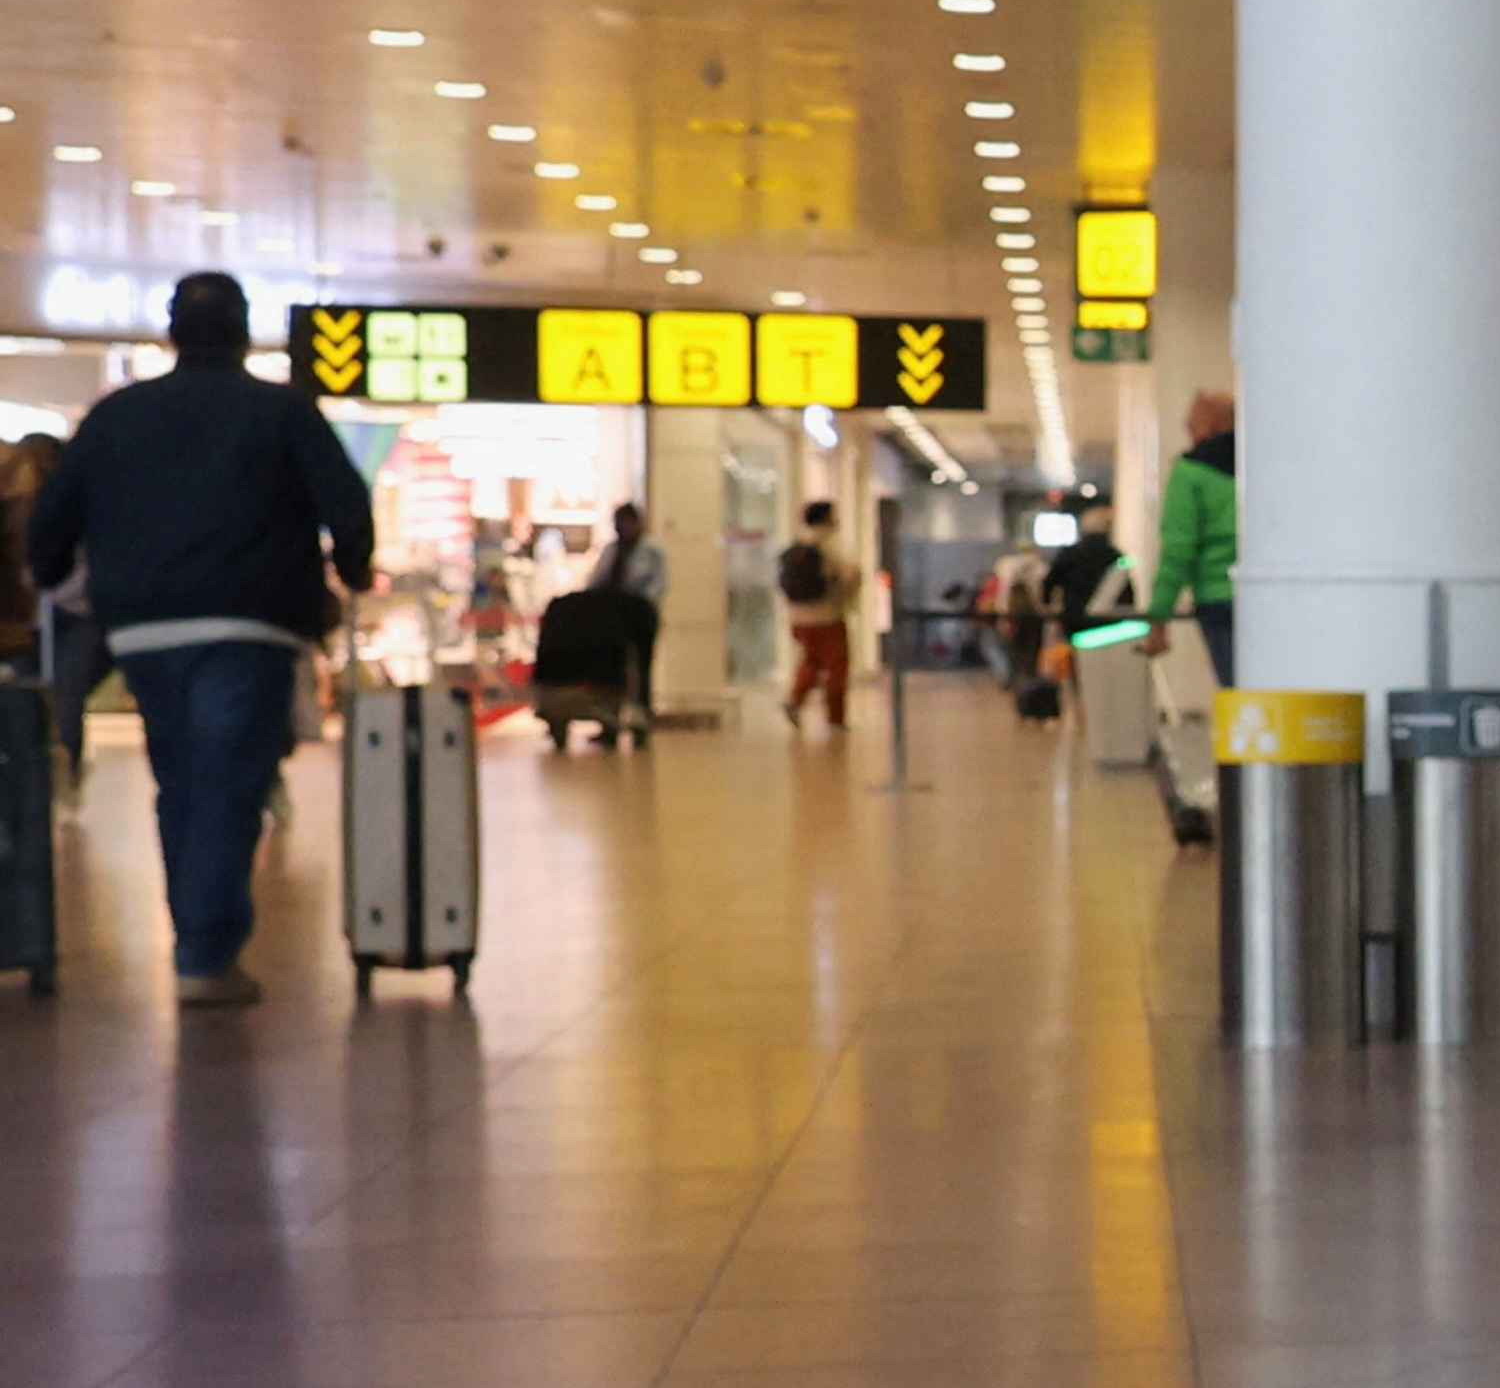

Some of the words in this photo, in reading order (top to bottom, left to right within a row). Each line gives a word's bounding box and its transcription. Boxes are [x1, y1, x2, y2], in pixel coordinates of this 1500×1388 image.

[570, 346, 612, 392] A
[678, 344, 721, 397] B
[788, 347, 828, 395] T
